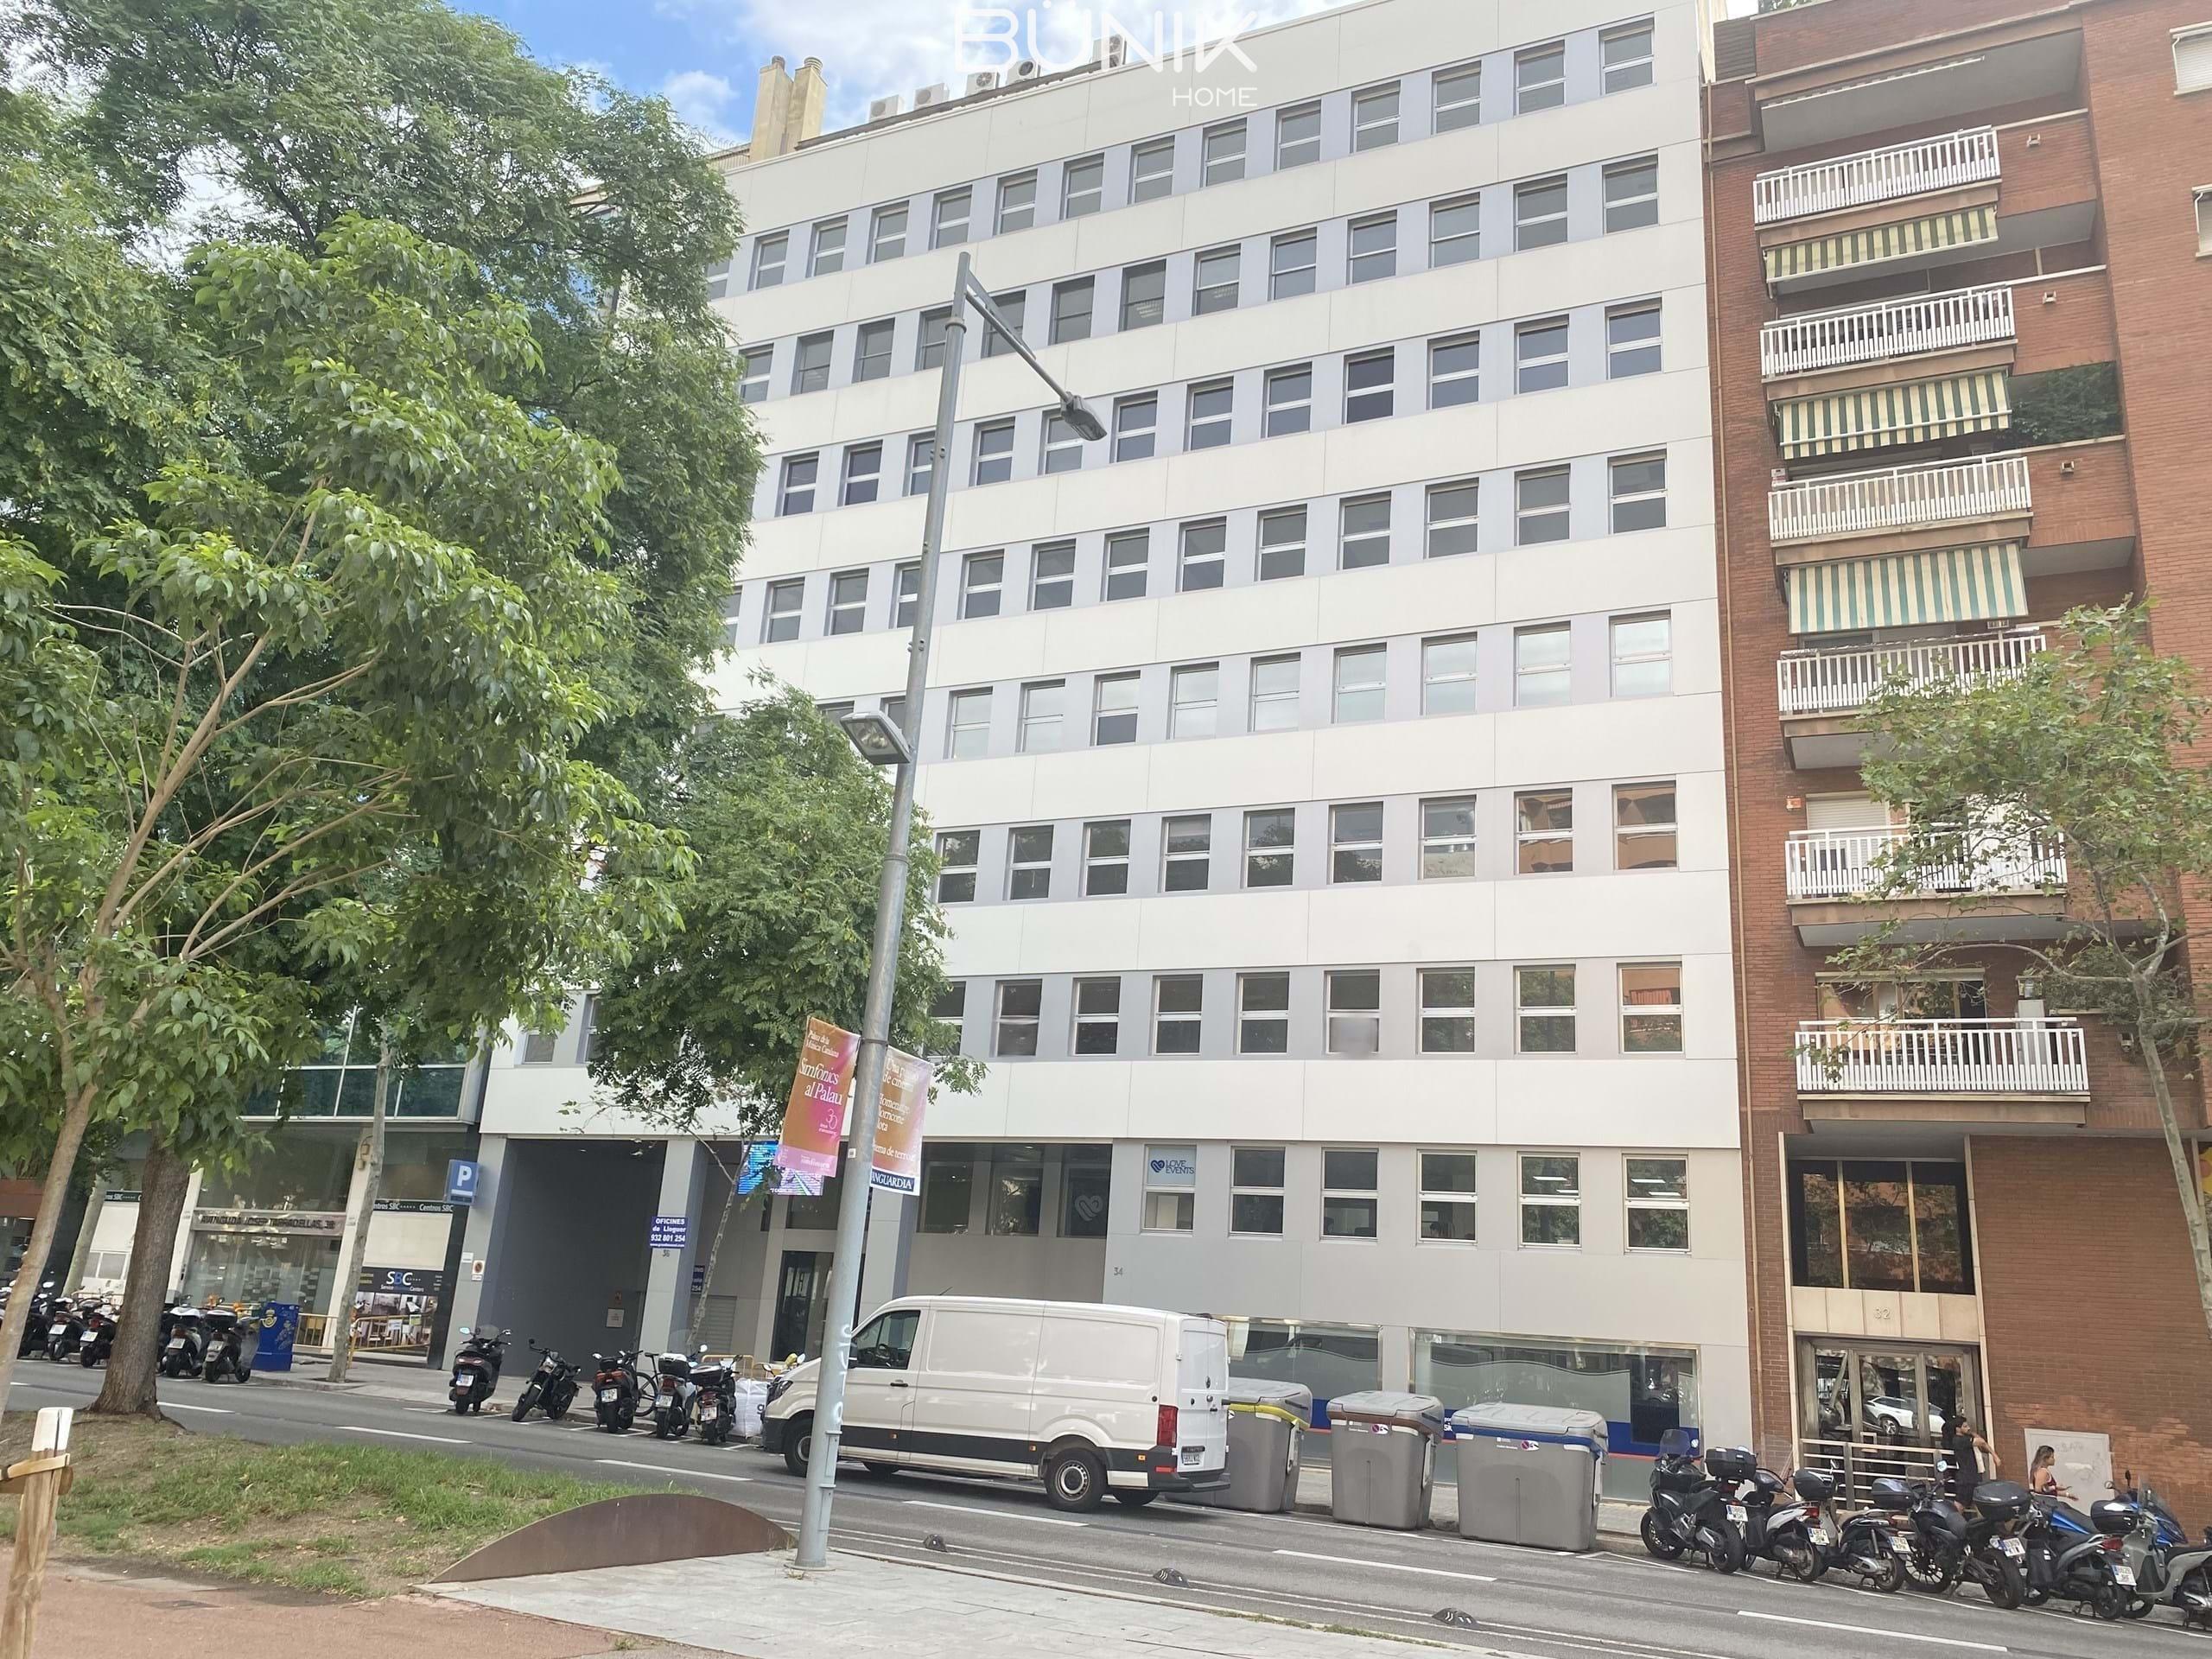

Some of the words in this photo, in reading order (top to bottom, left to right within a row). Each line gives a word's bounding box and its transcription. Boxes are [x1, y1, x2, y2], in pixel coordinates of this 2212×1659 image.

[804, 1082, 816, 1097] al
[814, 1083, 842, 1106] Palau
[456, 1165, 473, 1186] P
[872, 1171, 912, 1190] ANGUARDIA
[419, 1204, 441, 1212] Centros
[663, 1225, 686, 1234] Lloguer
[1114, 1267, 1123, 1276] 34
[386, 1271, 413, 1286] SBC
[1874, 1307, 1891, 1319] 32
